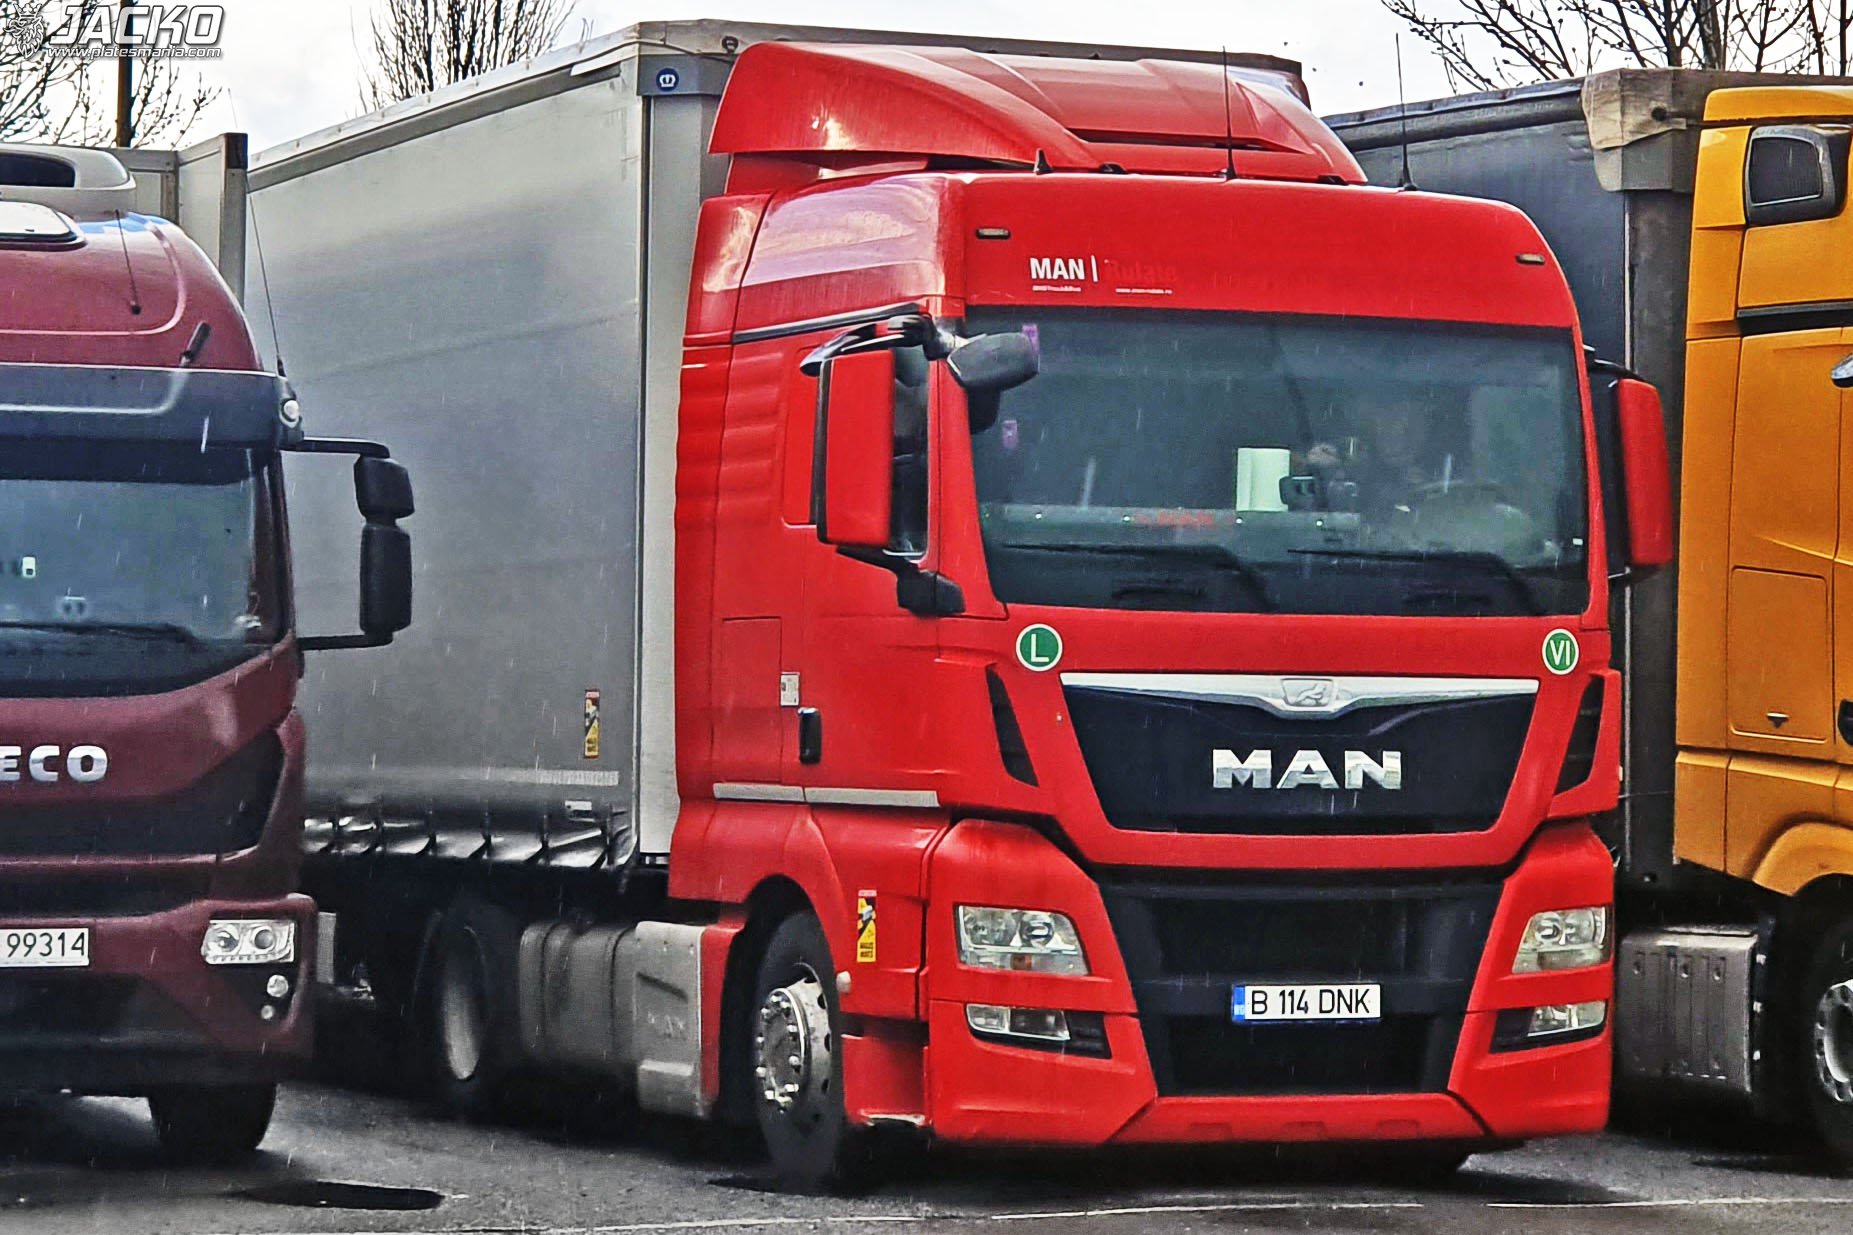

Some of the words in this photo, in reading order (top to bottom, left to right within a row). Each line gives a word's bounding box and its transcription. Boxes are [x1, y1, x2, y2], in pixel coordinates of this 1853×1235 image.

[1030, 257, 1085, 280] MAN
[1031, 633, 1050, 662] L
[1550, 639, 1570, 666] VI
[1213, 749, 1402, 789] MAN
[7, 931, 85, 958] 99314
[1251, 989, 1268, 1015] B
[1279, 988, 1309, 1015] 114
[1319, 987, 1370, 1014] DNK
